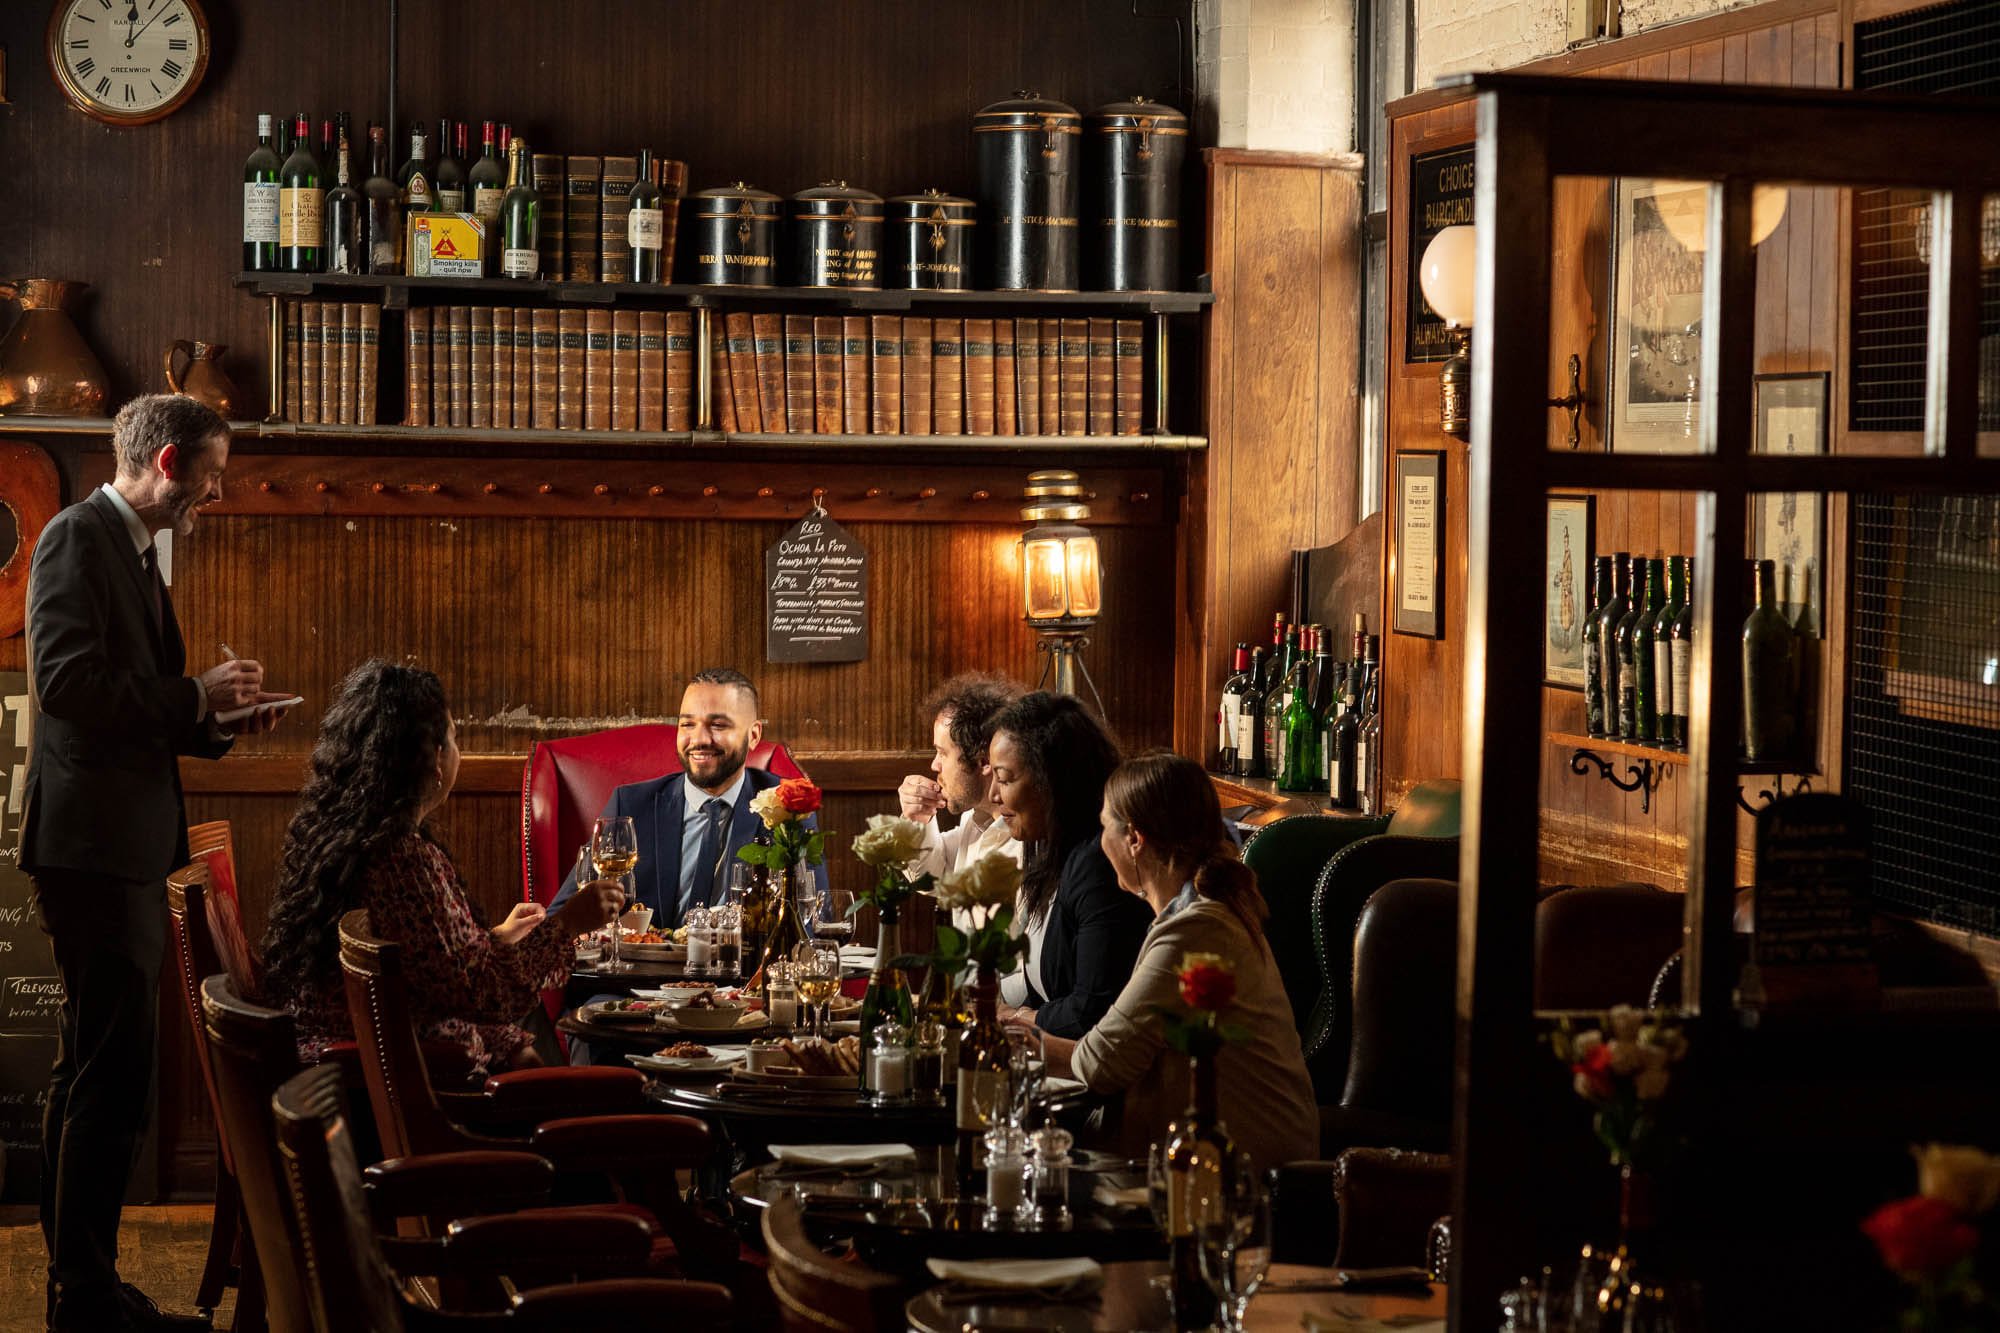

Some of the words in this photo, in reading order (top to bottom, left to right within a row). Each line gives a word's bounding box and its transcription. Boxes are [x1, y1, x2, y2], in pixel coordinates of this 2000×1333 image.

[1439, 161, 1474, 193] CHOICE
[1425, 196, 1475, 230] BURGUNDI
[433, 259, 463, 267] Smoking
[1415, 322, 1447, 346] ALWAYS
[10, 978, 64, 995] TELEVISE
